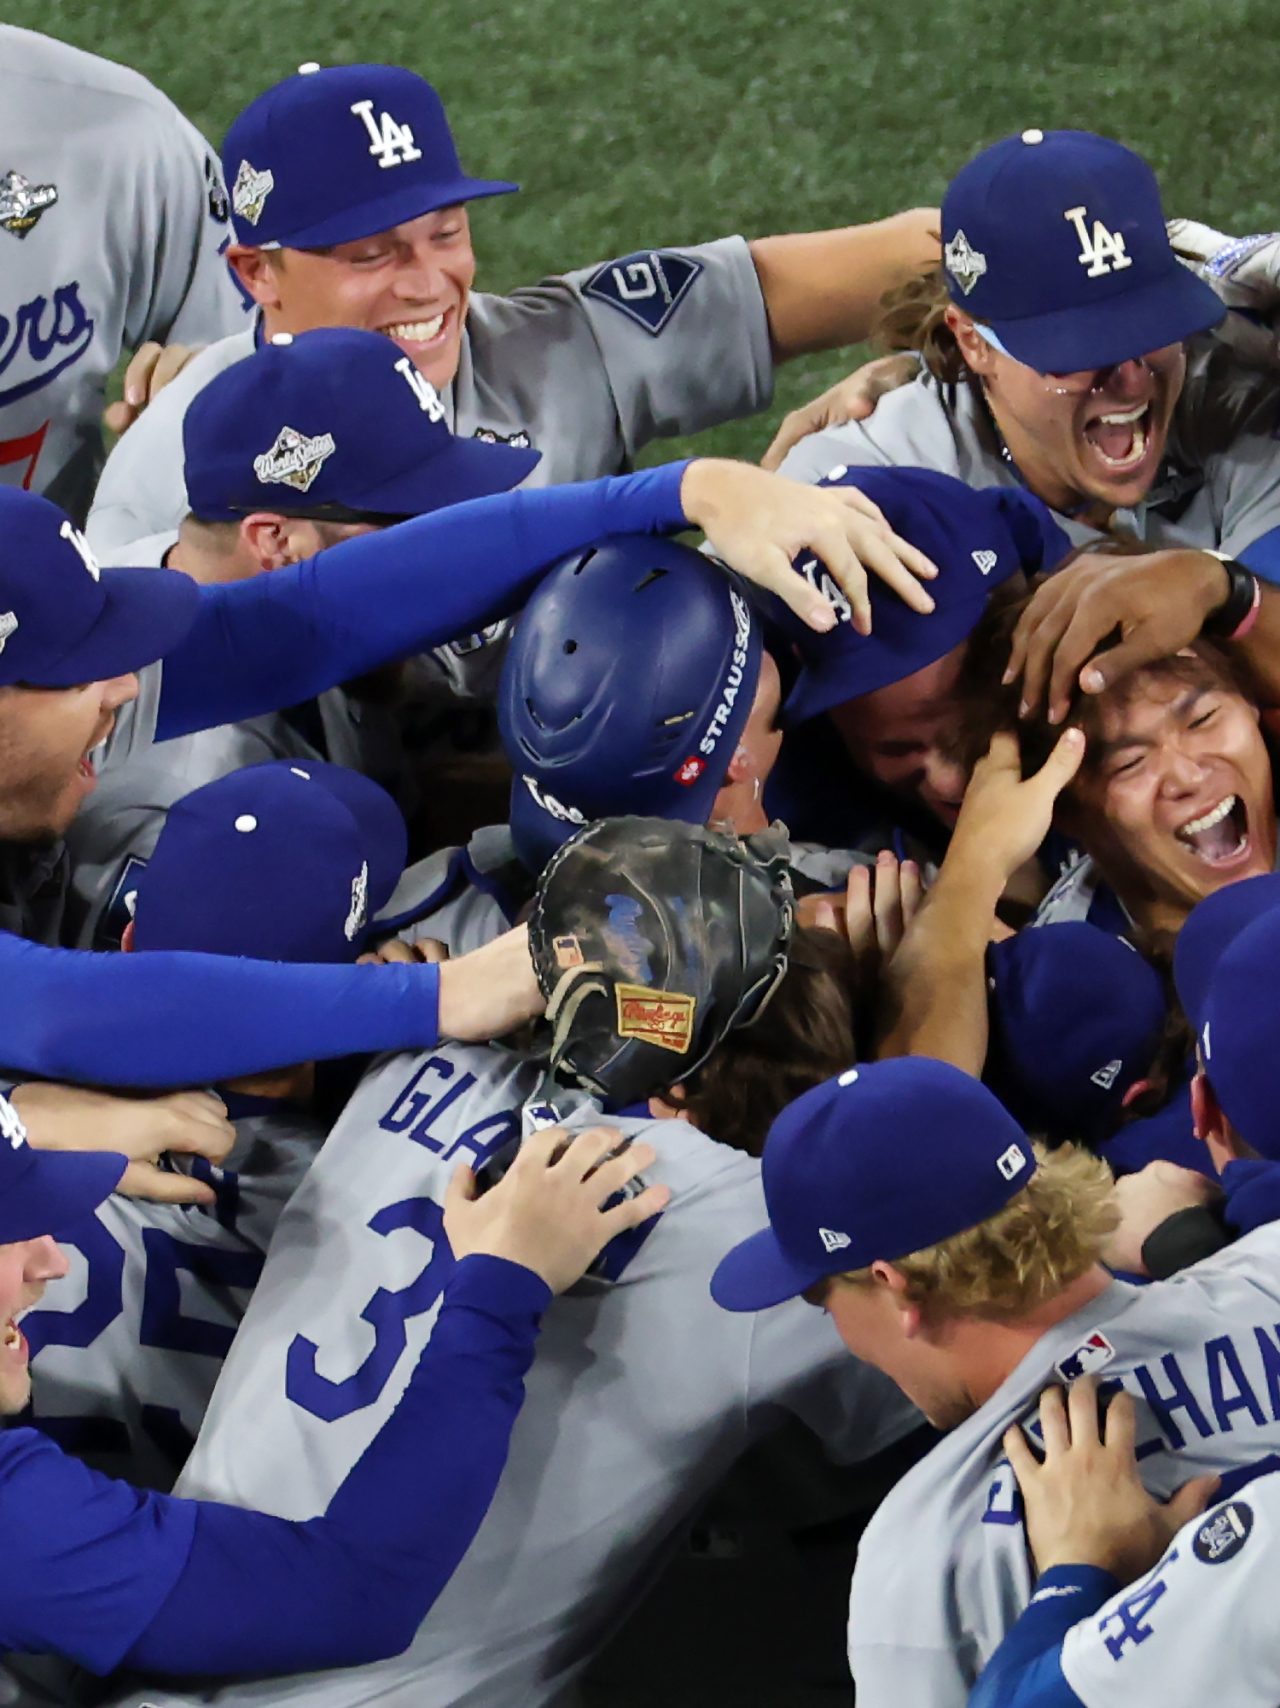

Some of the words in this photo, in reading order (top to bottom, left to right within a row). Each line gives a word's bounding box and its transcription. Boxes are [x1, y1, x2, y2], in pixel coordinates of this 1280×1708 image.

[351, 100, 422, 168] LA
[1064, 206, 1132, 277] LA
[394, 357, 445, 423] LA
[700, 631, 751, 755] STRAUSS
[378, 1056, 521, 1172] GLA
